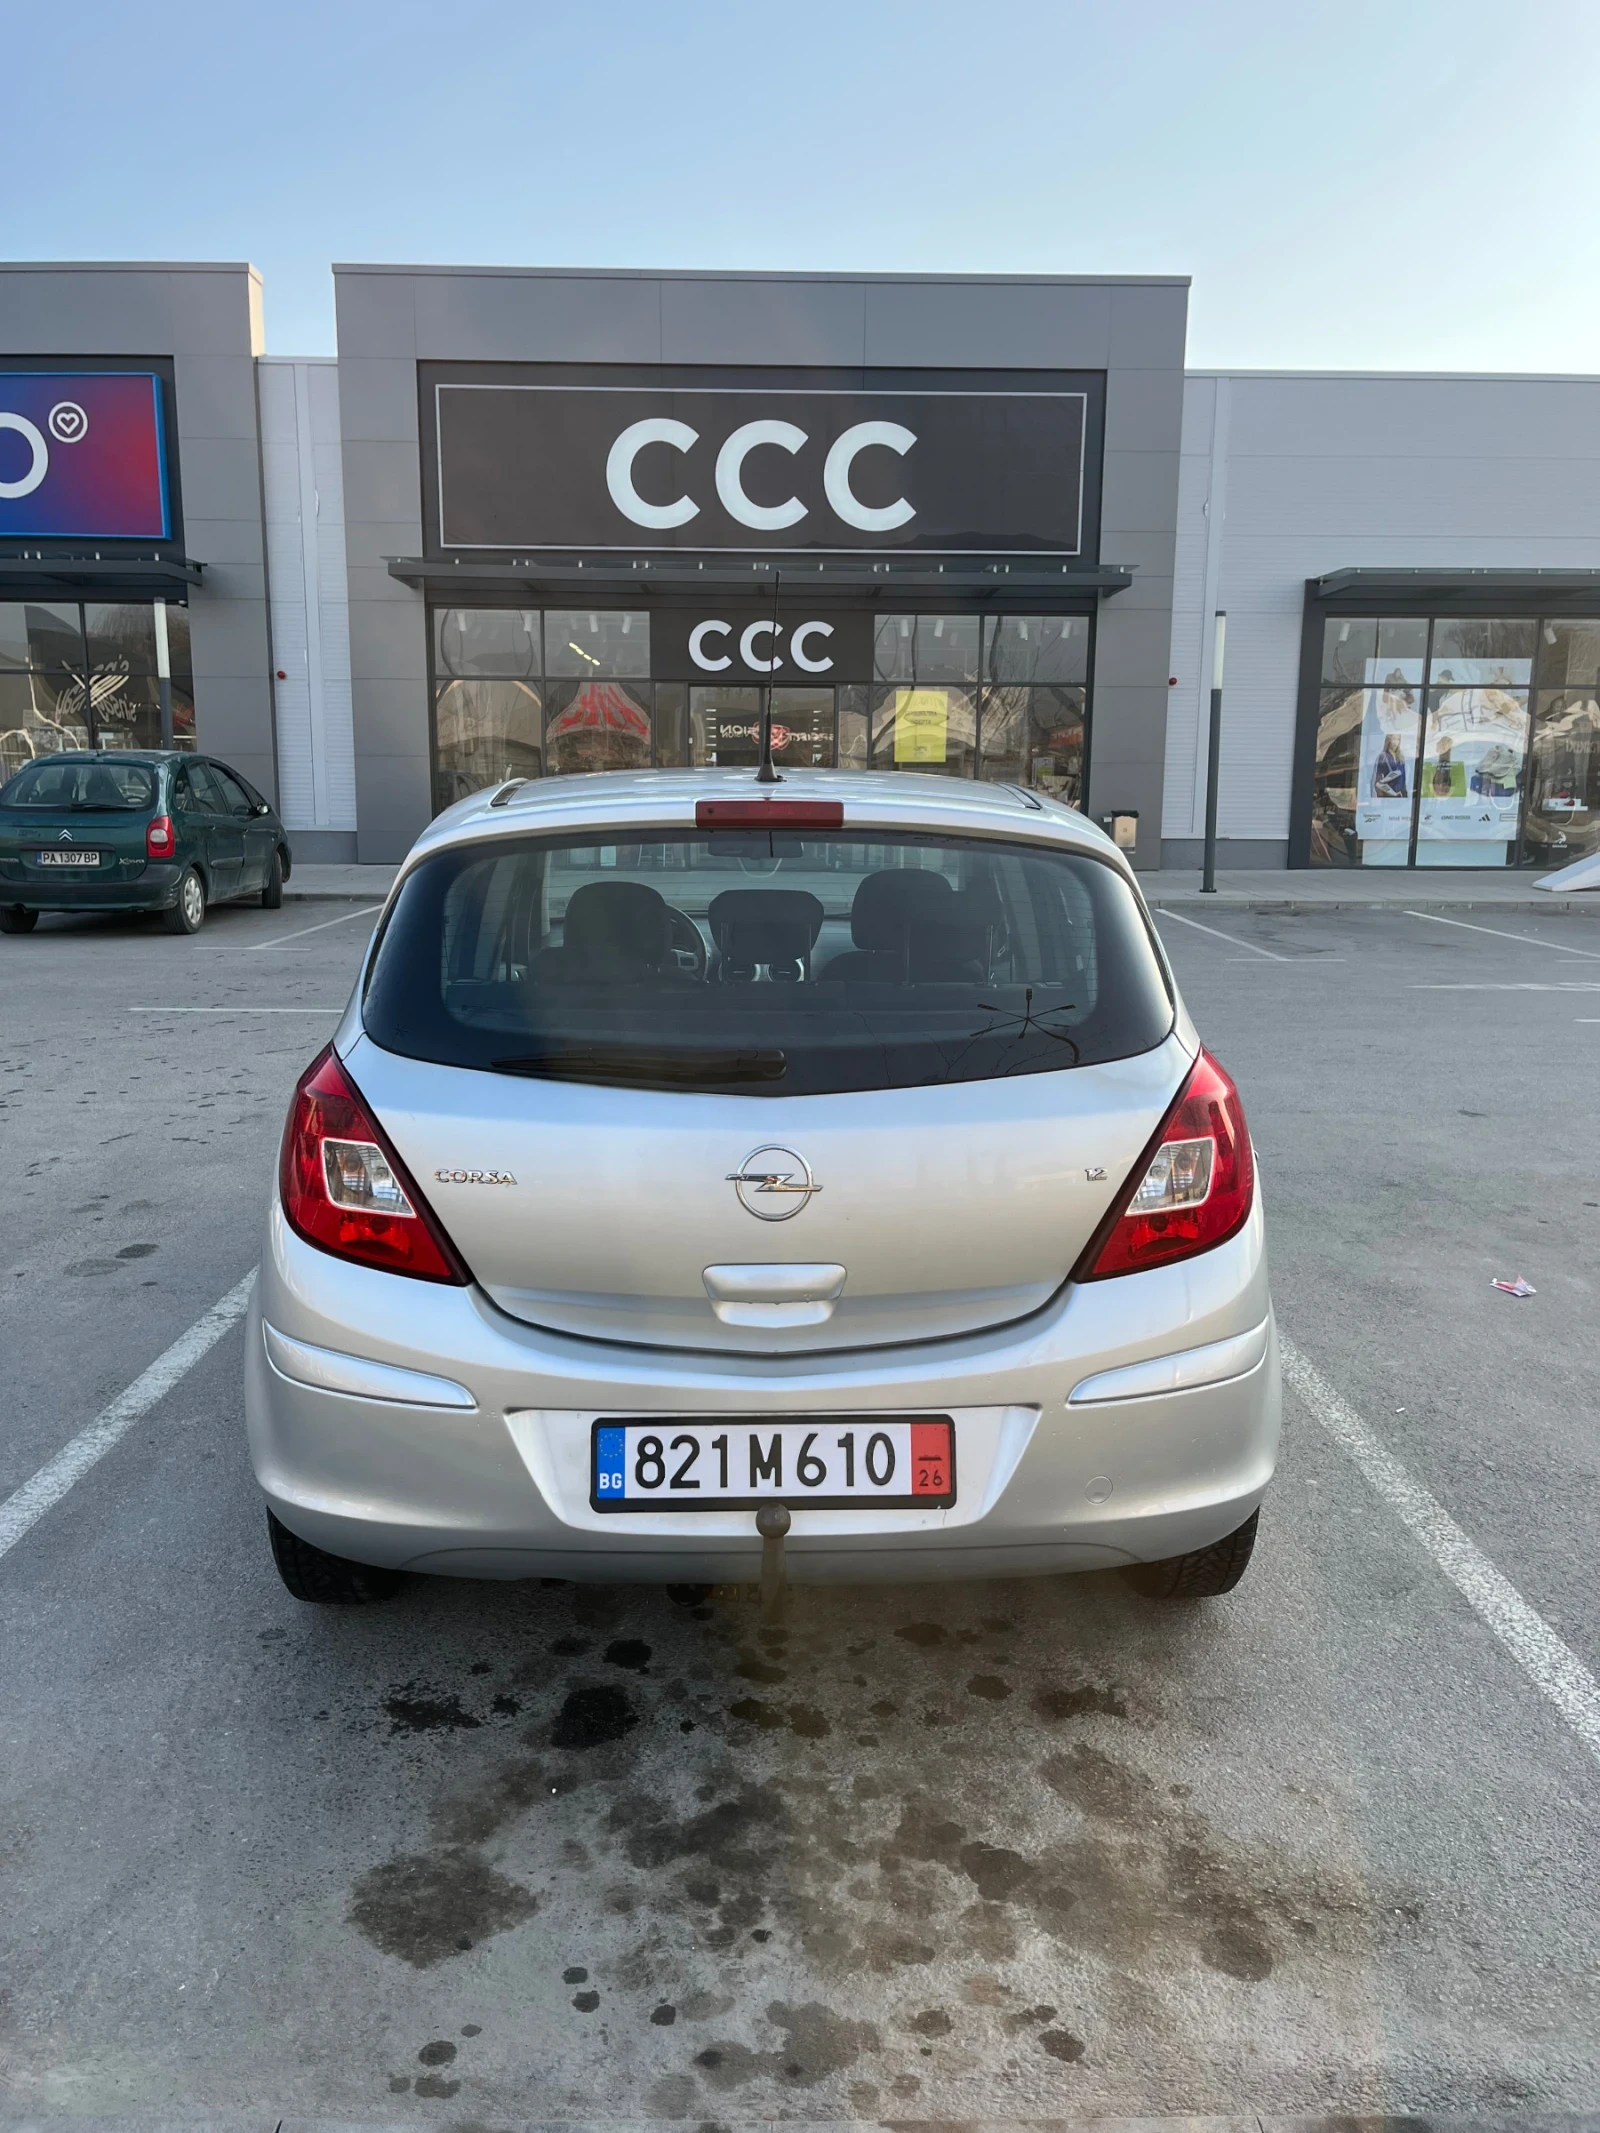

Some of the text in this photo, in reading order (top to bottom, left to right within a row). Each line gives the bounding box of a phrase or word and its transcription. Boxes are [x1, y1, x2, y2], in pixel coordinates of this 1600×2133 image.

[606, 418, 918, 531] CCC
[688, 619, 835, 672] CCC
[434, 1169, 518, 1185] CORSA
[600, 1473, 622, 1489] BG
[919, 1469, 943, 1486] 26
